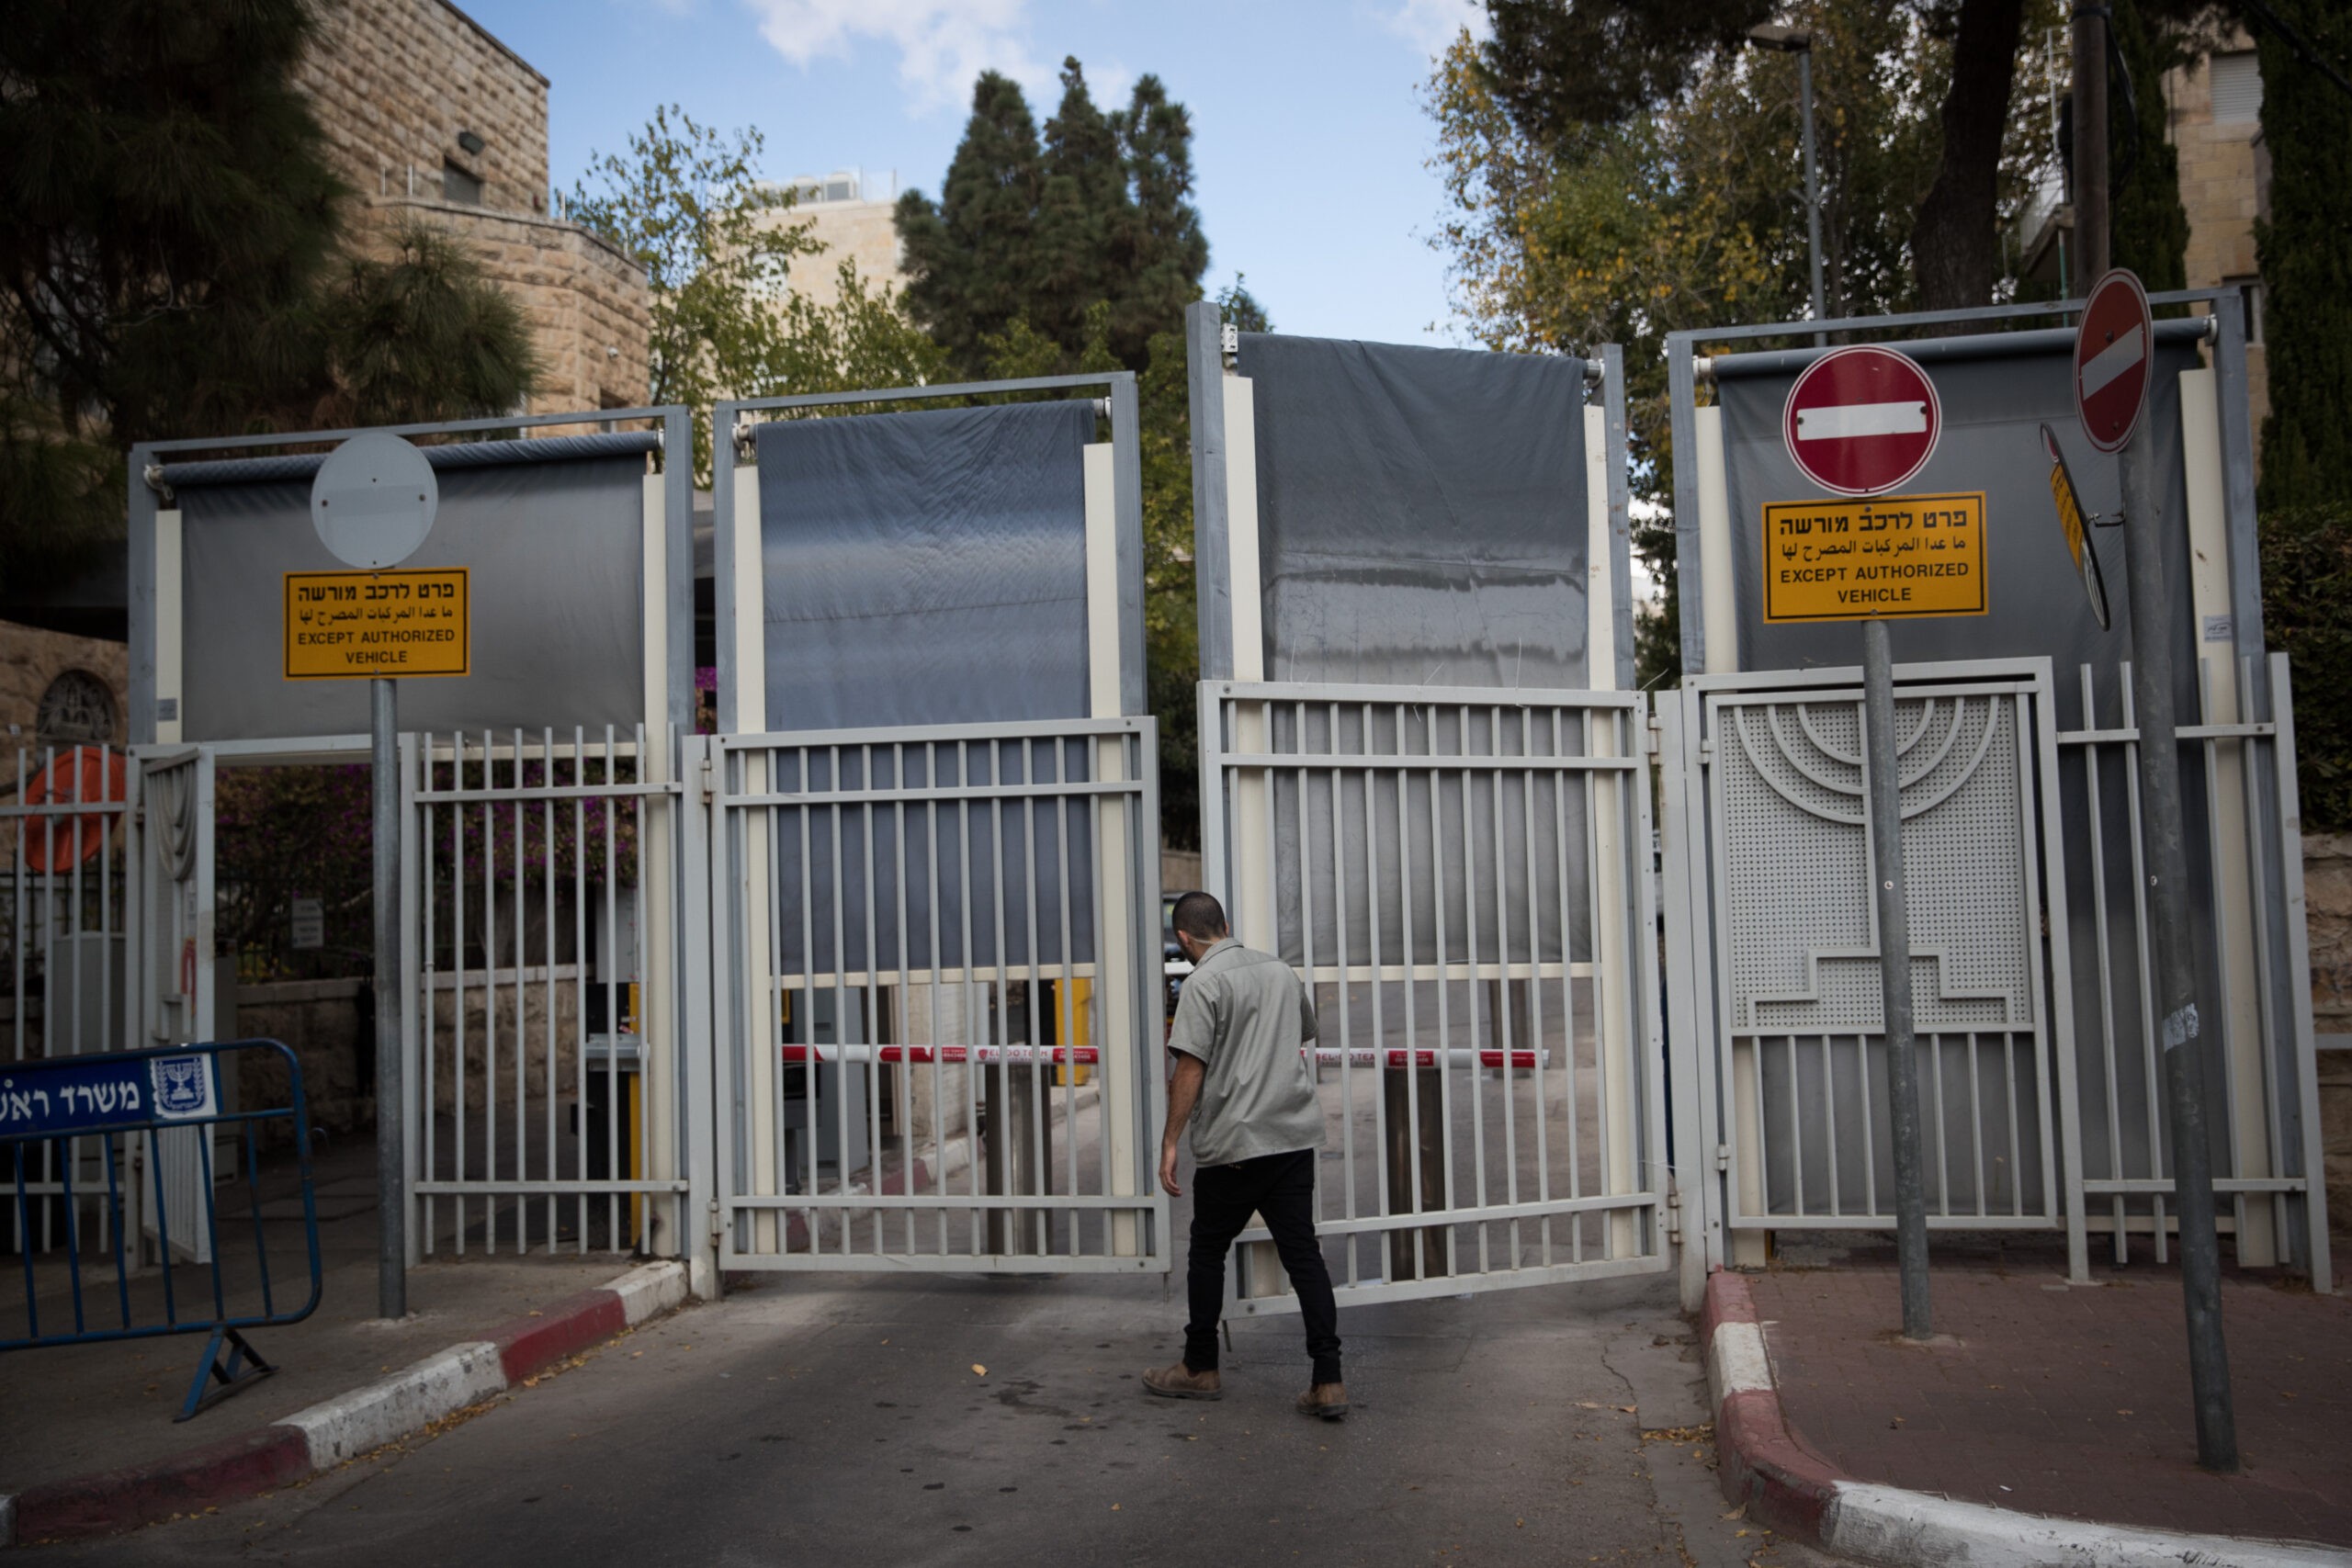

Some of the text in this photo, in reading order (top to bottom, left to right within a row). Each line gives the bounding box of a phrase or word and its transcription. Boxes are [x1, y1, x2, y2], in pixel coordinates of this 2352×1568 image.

[1781, 510, 1967, 536] פרט לרכב מורשה
[1925, 536, 1946, 551] عدا
[1953, 536, 1966, 548] ما
[1782, 544, 1797, 561] لها
[1781, 562, 1969, 583] EXCEPT AUTHORIZED
[298, 582, 455, 602] פרט לרכב מורשה
[1838, 588, 1912, 604] VEHICLE
[300, 608, 313, 625] لها
[419, 606, 436, 618] عدا
[442, 605, 452, 617] ما
[298, 629, 455, 645] EXCEPT AUTHORIZED
[345, 651, 407, 664] VEHICLE
[989, 1048, 1021, 1057] ELGO
[60, 1081, 141, 1115] משרד
